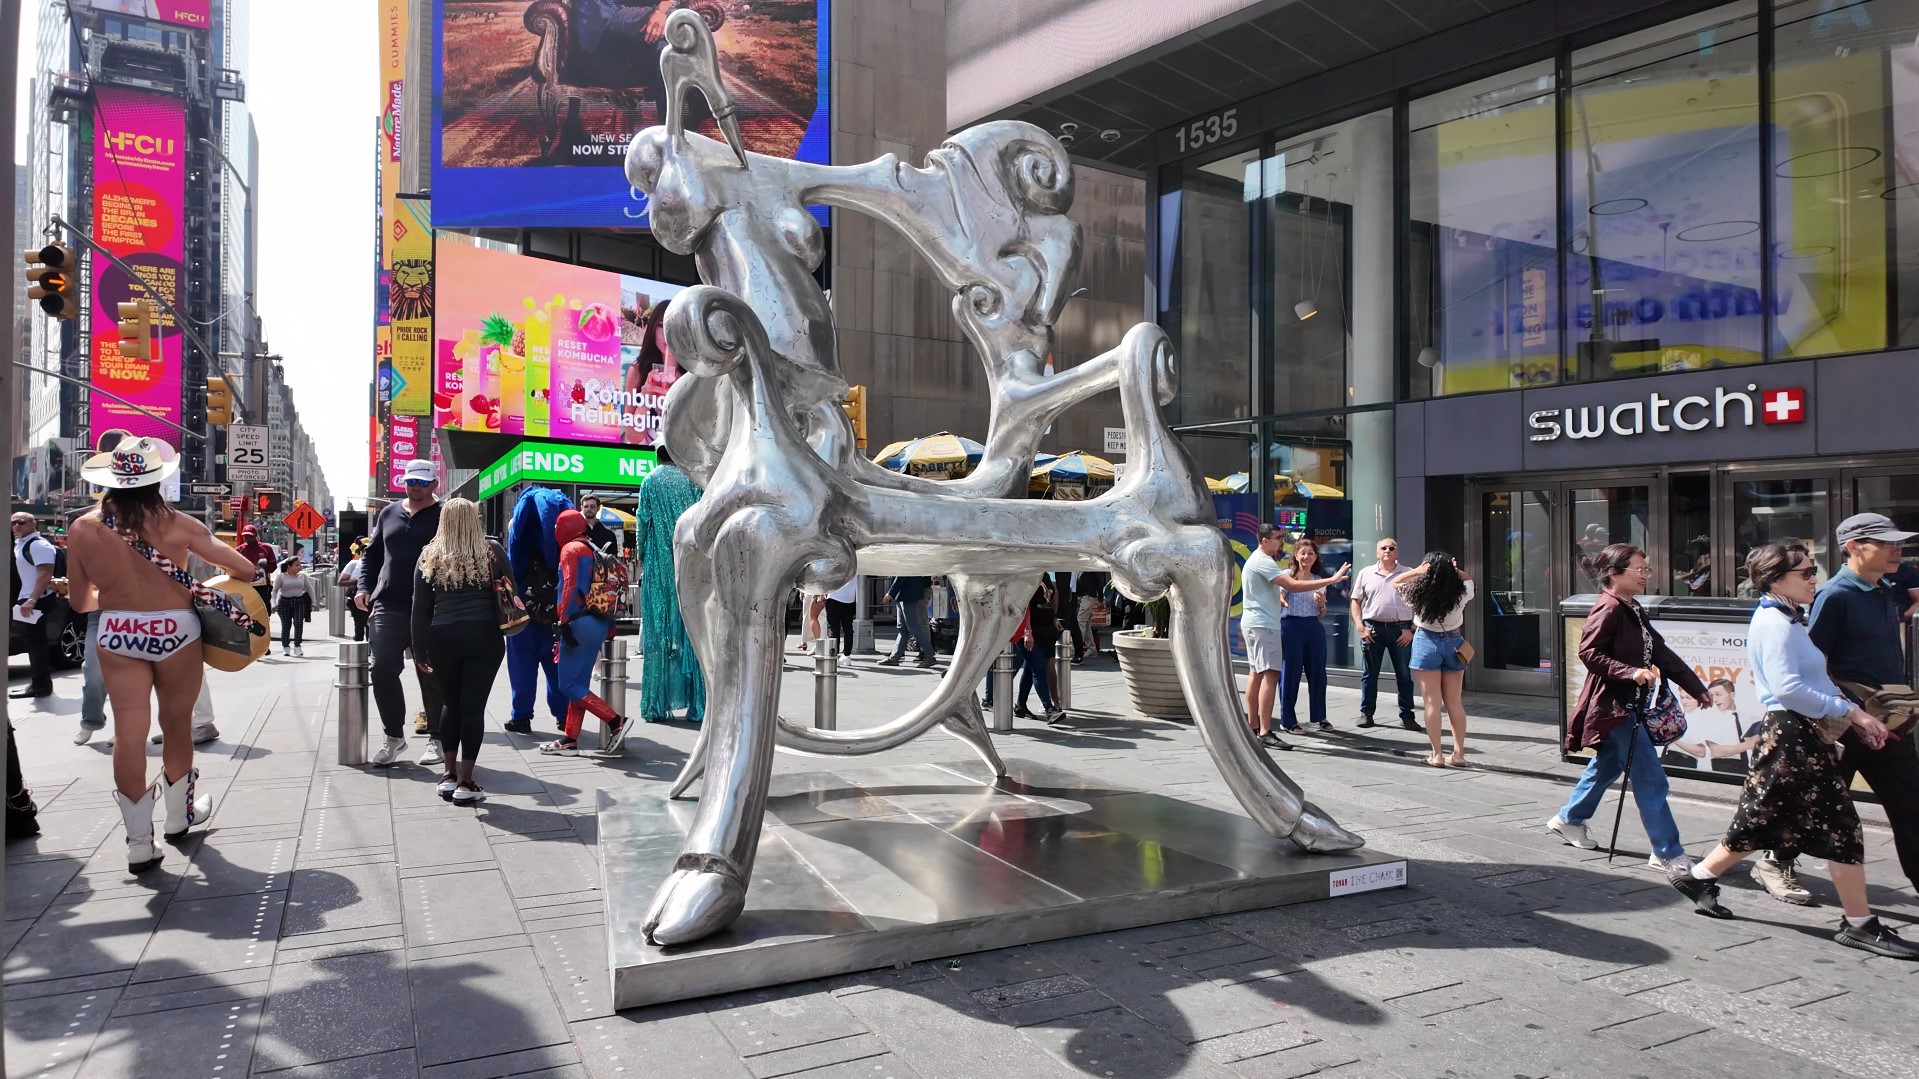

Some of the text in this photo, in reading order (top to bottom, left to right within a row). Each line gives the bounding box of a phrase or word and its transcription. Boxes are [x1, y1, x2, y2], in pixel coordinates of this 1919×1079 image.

[391, 5, 399, 68] GUMMIES
[1175, 108, 1238, 153] 1535
[104, 129, 174, 156] HFCU
[590, 133, 633, 143] NEW SE
[572, 144, 629, 155] NOW STR
[102, 200, 132, 210] BEGINS
[102, 207, 119, 215] THE
[101, 213, 158, 228] DECADES
[101, 221, 135, 232] BEFORE
[101, 228, 143, 239] THE FIRST
[159, 267, 176, 275] ARE
[396, 326, 428, 334] PRIDE ROCK
[401, 333, 428, 342] CALLING
[99, 341, 117, 349] THE
[557, 339, 588, 351] RESET
[99, 347, 112, 355] TO
[557, 350, 614, 364] KOMBUCHA
[99, 361, 150, 371] YOUR BRAIN
[109, 368, 150, 381] NOW.
[445, 372, 463, 381] RES
[585, 383, 665, 410] Kombuc
[571, 403, 662, 433] Reimagin
[1528, 386, 1754, 442] swatch
[1107, 441, 1119, 449] KEEP
[112, 451, 145, 464] NAKED
[233, 448, 264, 464] 25
[105, 617, 177, 636] NAKED
[99, 633, 188, 655] COWBOY
[1664, 635, 1696, 645] OOK
[1700, 636, 1717, 646] OF
[1707, 656, 1750, 666] THEATE
[1350, 873, 1367, 887] THE
[1369, 870, 1394, 884] CHAIR
